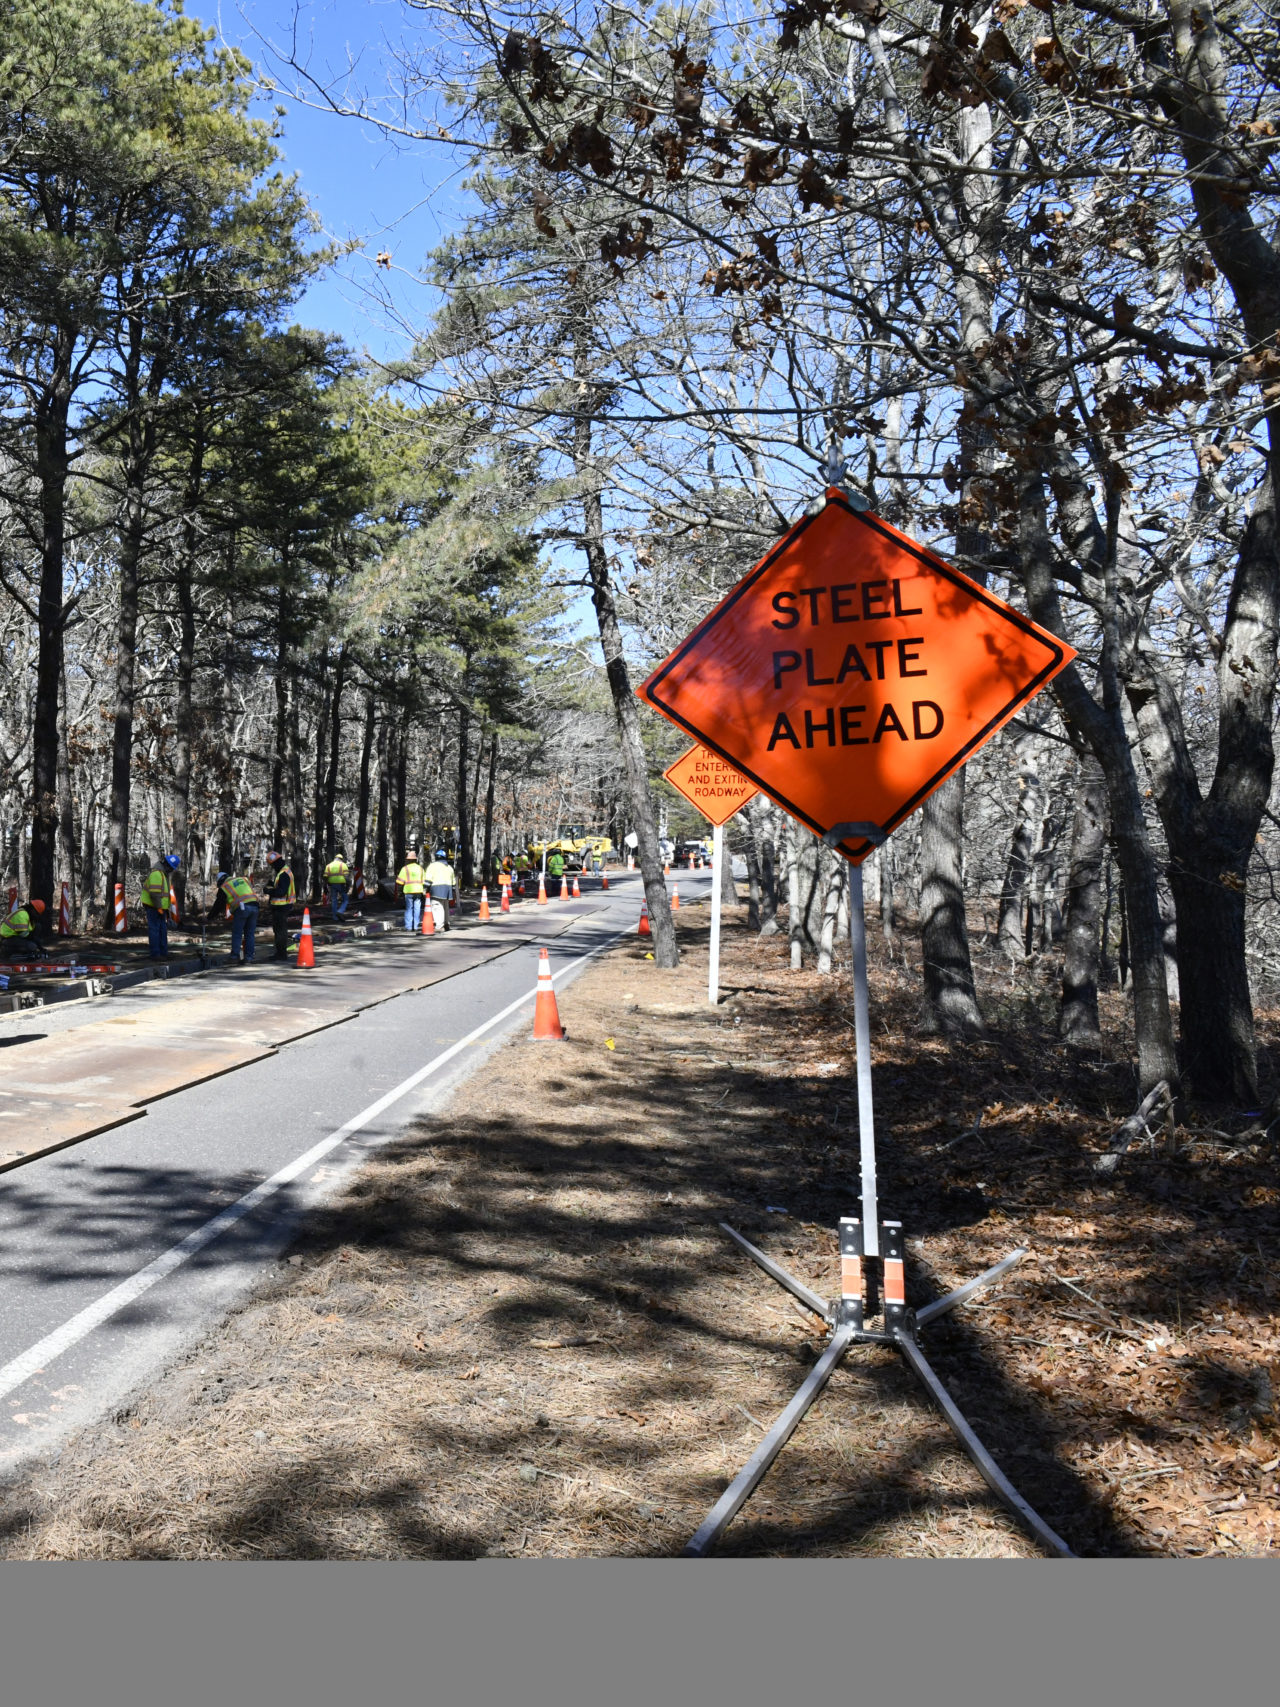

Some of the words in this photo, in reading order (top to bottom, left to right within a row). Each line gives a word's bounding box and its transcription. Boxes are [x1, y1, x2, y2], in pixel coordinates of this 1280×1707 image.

[771, 579, 923, 631] STEEL
[772, 637, 928, 690] PLATE
[766, 700, 945, 752] AHEAD
[687, 775, 710, 784] AND
[714, 774, 748, 784] EXITIN
[695, 763, 733, 772] ENTER
[695, 787, 746, 797] ROADWAY
